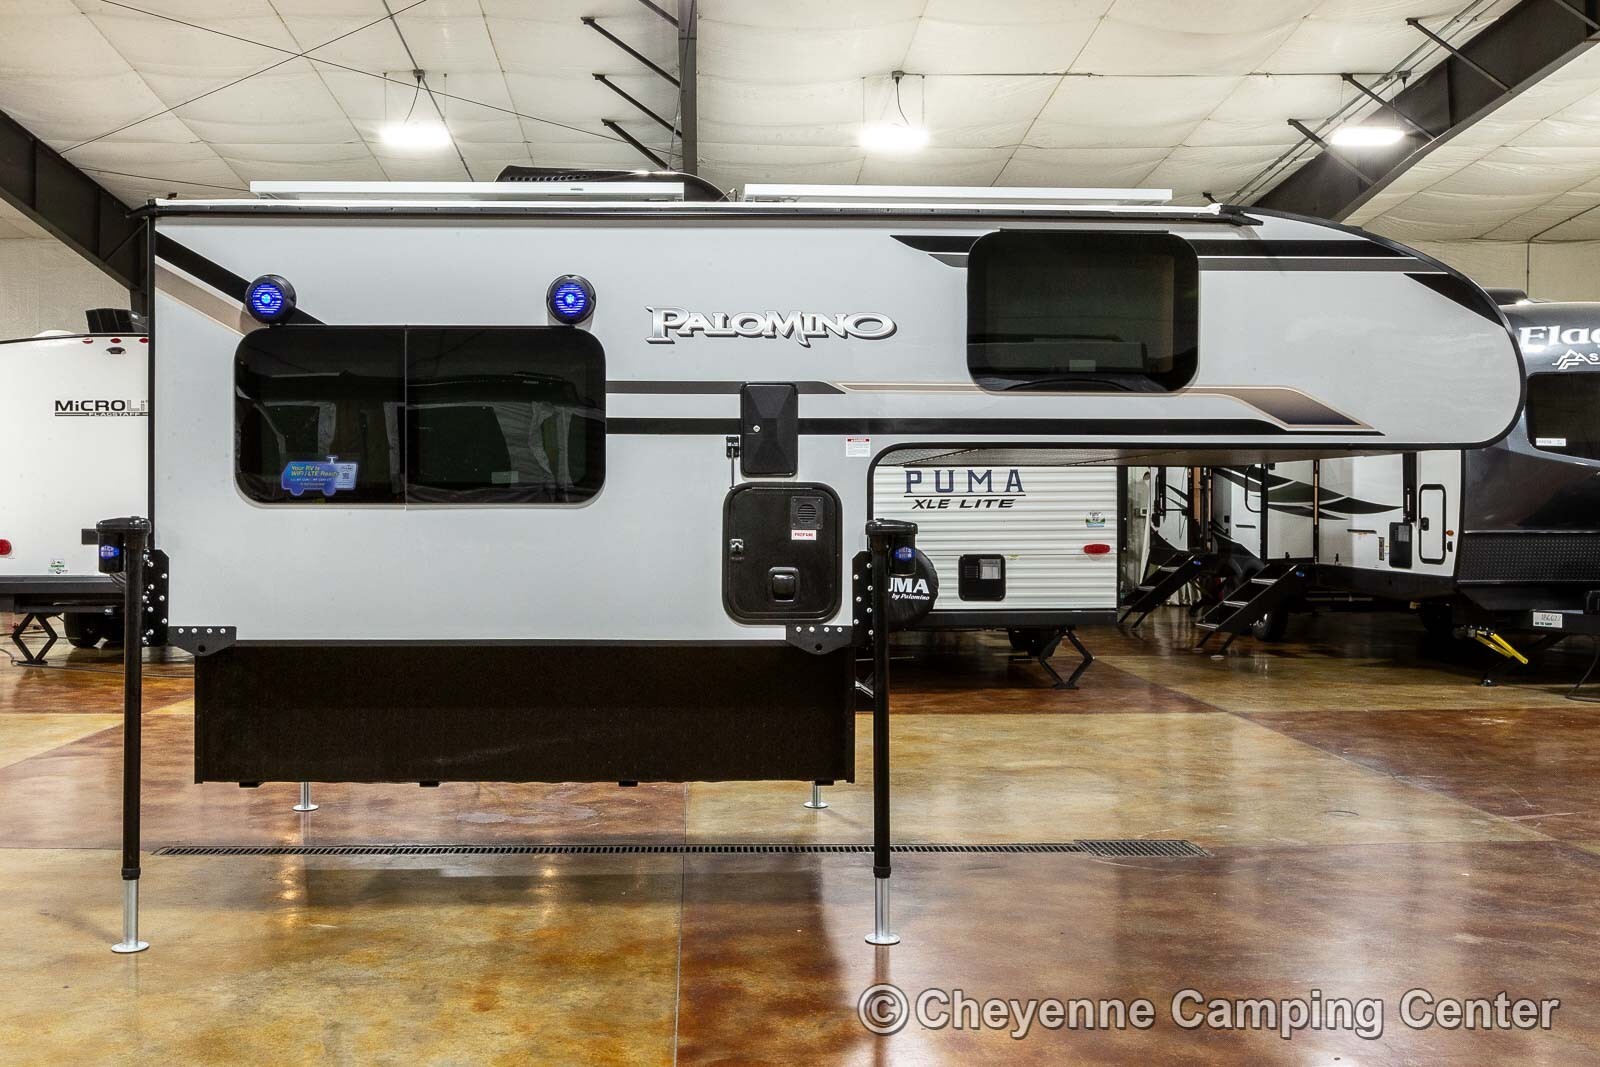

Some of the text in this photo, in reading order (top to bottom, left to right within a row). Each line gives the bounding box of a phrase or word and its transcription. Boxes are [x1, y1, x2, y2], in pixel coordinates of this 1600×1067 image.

[645, 306, 897, 348] PALOMINO
[905, 469, 1024, 493] PUMA
[912, 499, 1016, 509] XLE LITE
[892, 593, 930, 601] by Palomino
